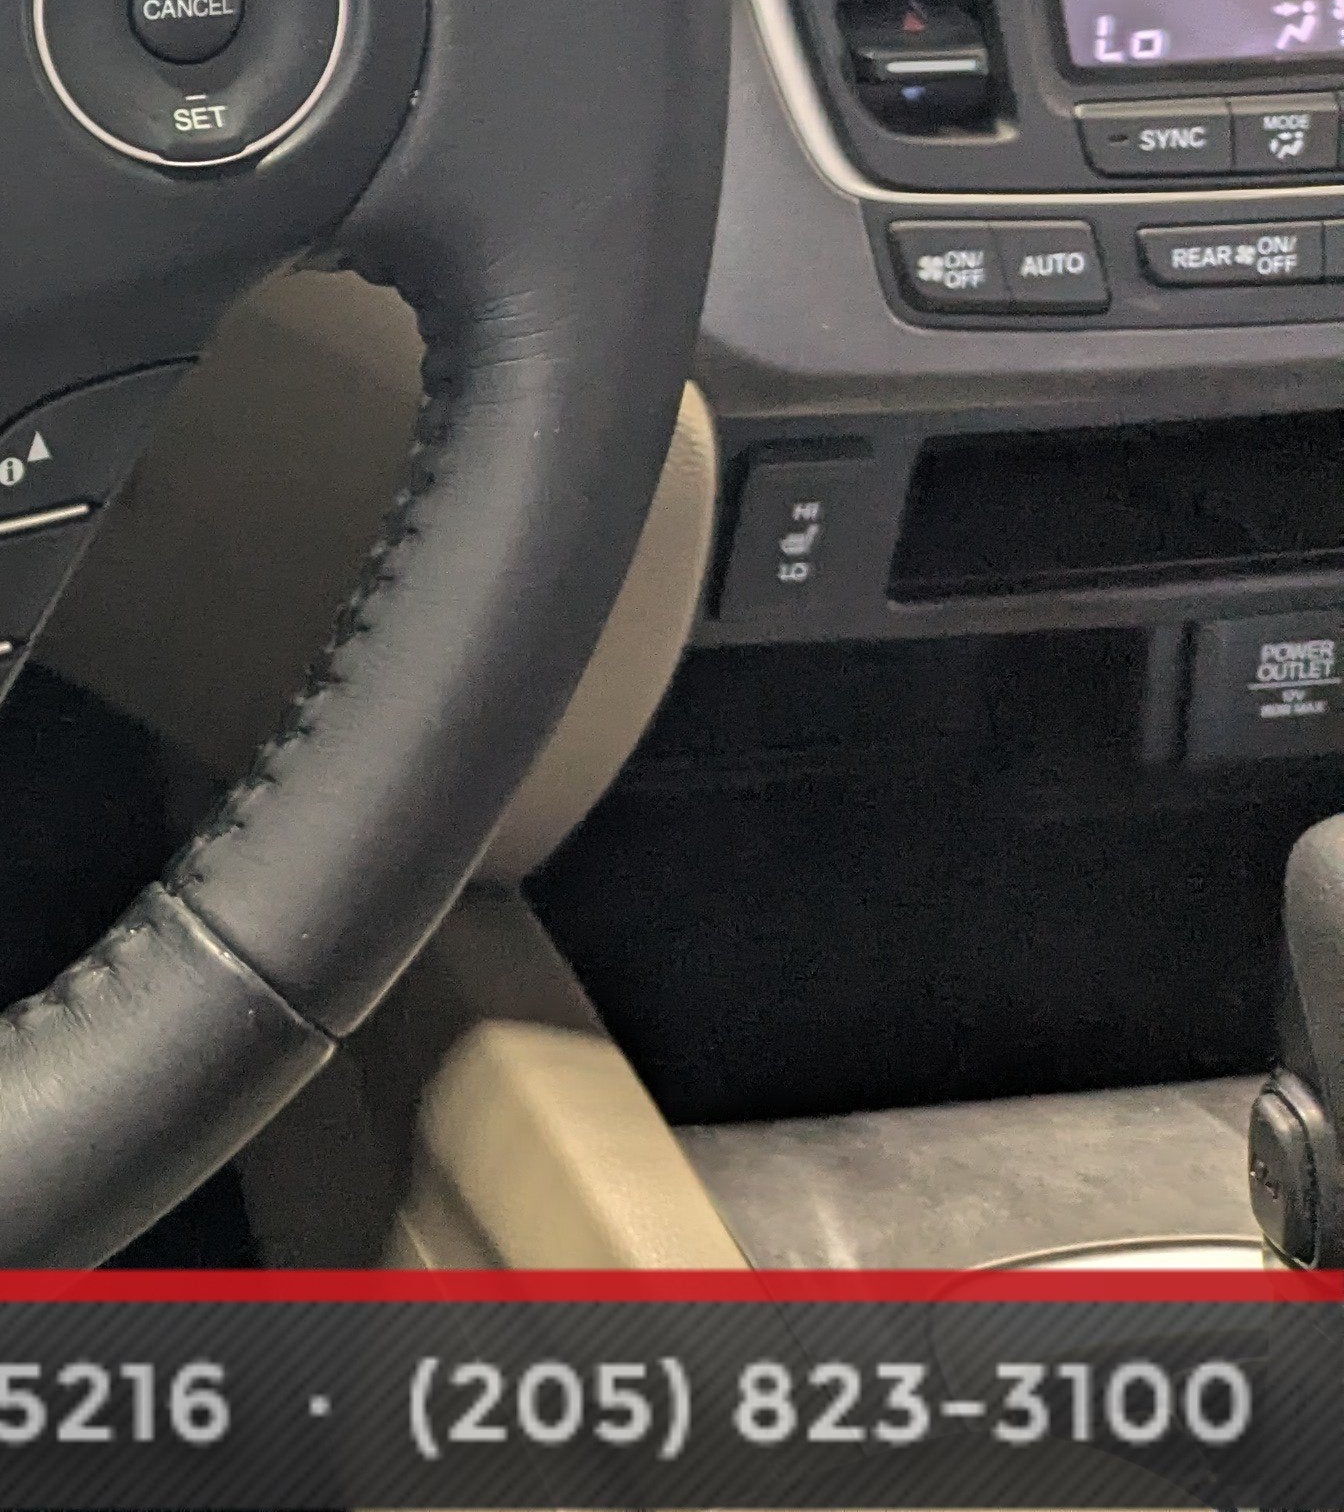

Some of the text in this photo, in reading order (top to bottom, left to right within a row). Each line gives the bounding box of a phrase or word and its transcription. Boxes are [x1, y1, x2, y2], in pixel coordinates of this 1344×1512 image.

[173, 105, 229, 131] SET
[1263, 114, 1310, 130] MODE
[1139, 126, 1207, 151] SYNC
[1020, 253, 1085, 277] AUTO
[1172, 247, 1233, 269] REAR
[1256, 255, 1297, 276] OFF
[943, 268, 985, 290] OFF
[1261, 640, 1334, 664] POWER
[1257, 660, 1333, 682] OUTLET
